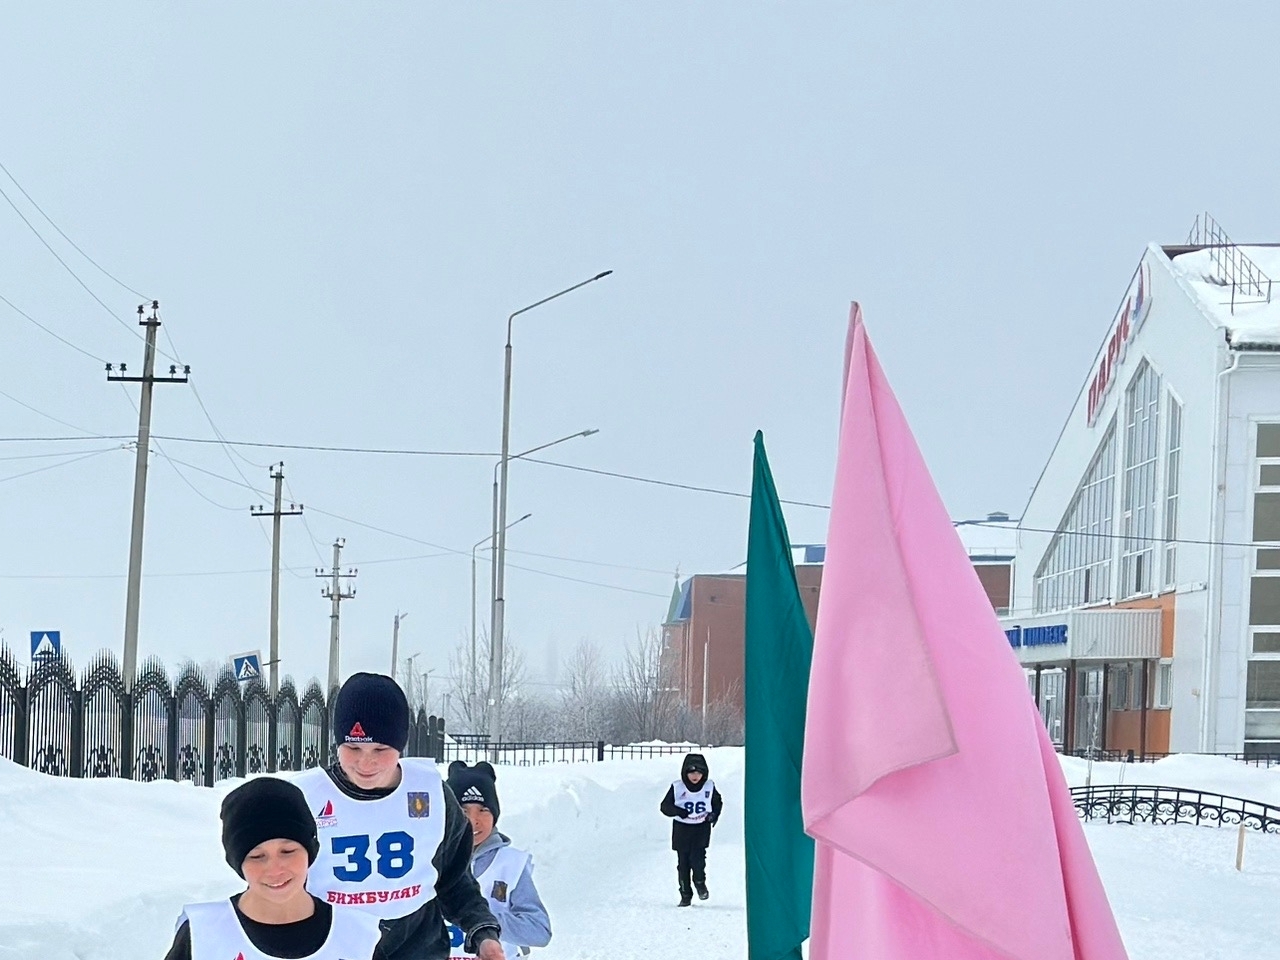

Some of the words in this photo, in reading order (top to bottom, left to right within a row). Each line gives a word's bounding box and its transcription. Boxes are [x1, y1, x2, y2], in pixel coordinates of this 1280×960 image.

[1086, 295, 1132, 428] ПАРУС
[684, 801, 706, 814] 86
[331, 831, 414, 882] 38
